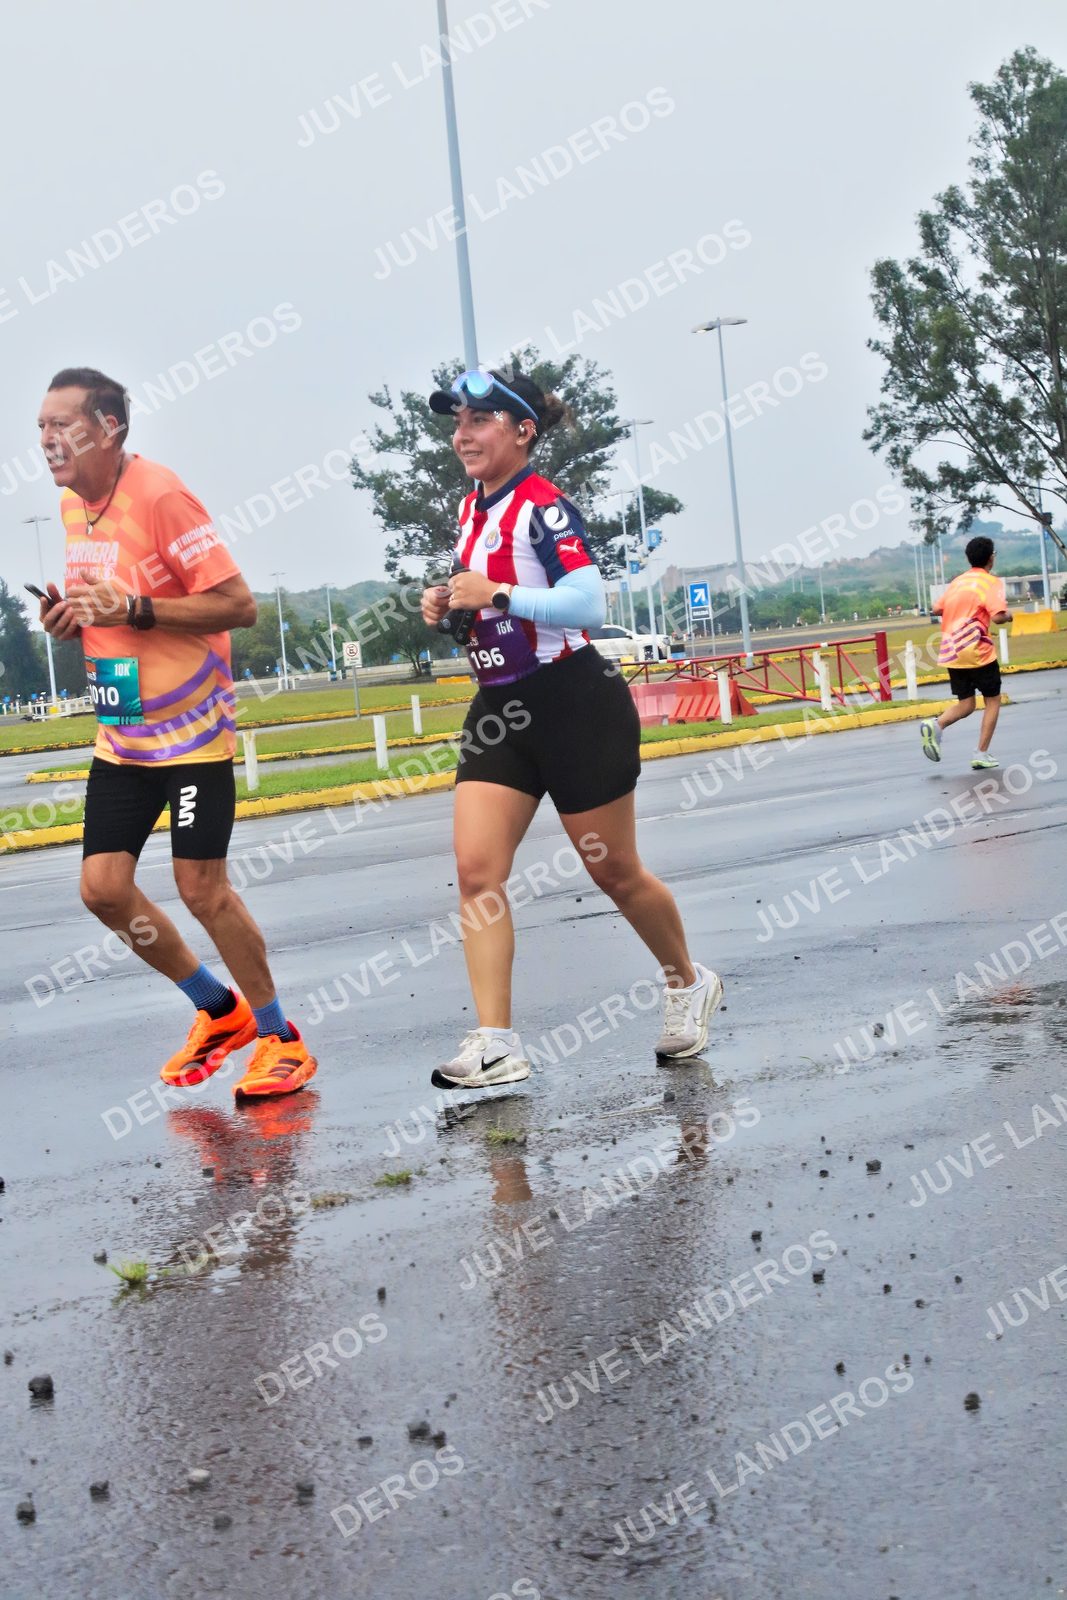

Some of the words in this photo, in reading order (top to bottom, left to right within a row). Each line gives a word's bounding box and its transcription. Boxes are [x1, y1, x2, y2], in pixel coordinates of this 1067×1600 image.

[553, 528, 575, 541] pepsi
[470, 647, 505, 669] 196
[114, 663, 131, 677] 10K
[89, 684, 120, 706] 010
